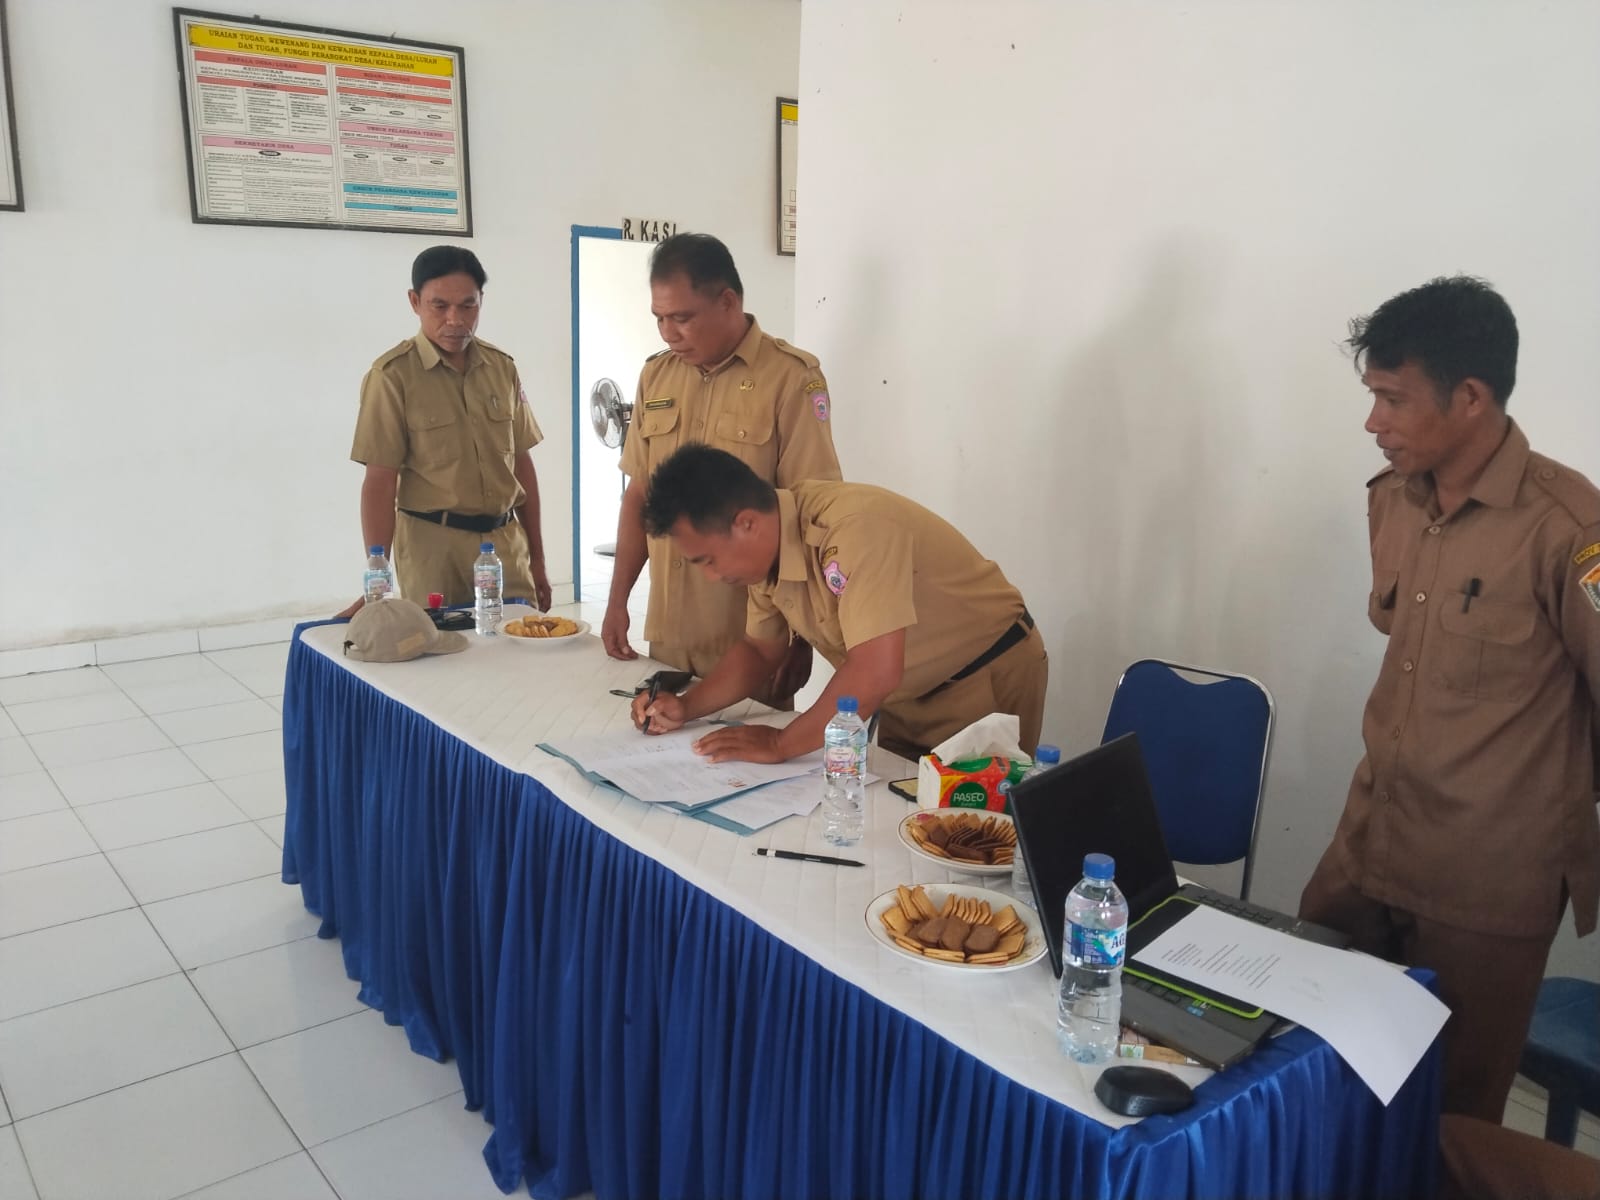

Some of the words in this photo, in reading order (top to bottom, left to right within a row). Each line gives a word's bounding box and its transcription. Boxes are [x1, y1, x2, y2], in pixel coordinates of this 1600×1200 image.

[208, 29, 238, 39] URAIAN
[311, 43, 326, 51] DAN
[368, 50, 395, 59] KEPALA
[238, 42, 253, 50] DAN
[624, 218, 634, 241] R.
[953, 792, 985, 802] PASEO
